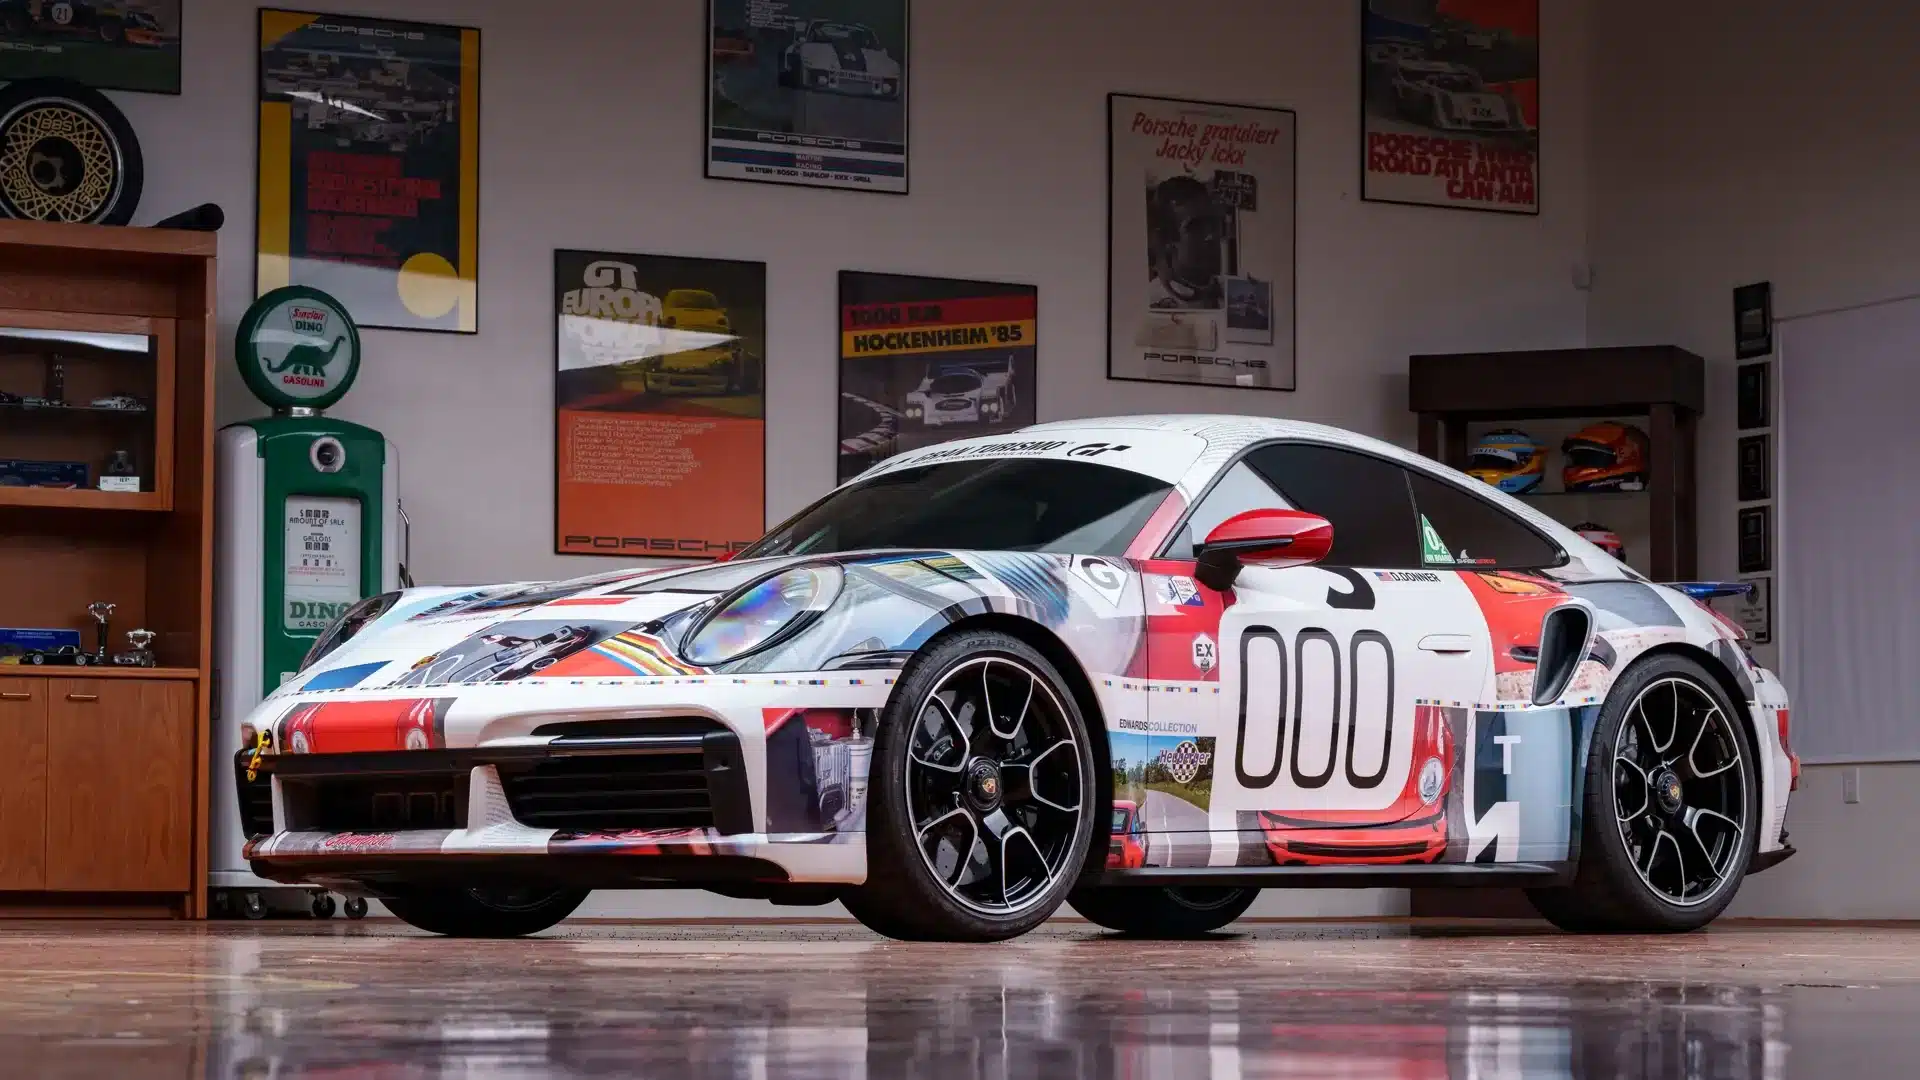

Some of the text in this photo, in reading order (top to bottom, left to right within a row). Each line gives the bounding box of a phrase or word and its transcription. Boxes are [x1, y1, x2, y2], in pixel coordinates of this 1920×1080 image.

[308, 24, 425, 41] PORSCHE
[41, 118, 73, 131] BBS
[1132, 112, 1280, 146] Porsche gratuliert
[757, 132, 862, 149] PORSCHE
[1156, 138, 1246, 167] Jacky Ickx
[777, 168, 799, 177] BOSCH
[796, 163, 823, 171] RACING
[584, 260, 638, 290] GT
[295, 320, 323, 332] DINO
[854, 325, 1022, 353] HOCKENHEIM '85
[1144, 353, 1268, 368] PORSCHE
[283, 376, 325, 387] GASOLINE
[289, 517, 318, 525] AMOUNT
[1389, 571, 1441, 582] D.DONNER
[1195, 643, 1213, 657] EX
[1235, 625, 1394, 789] 000
[1160, 750, 1210, 768] Heuberger
